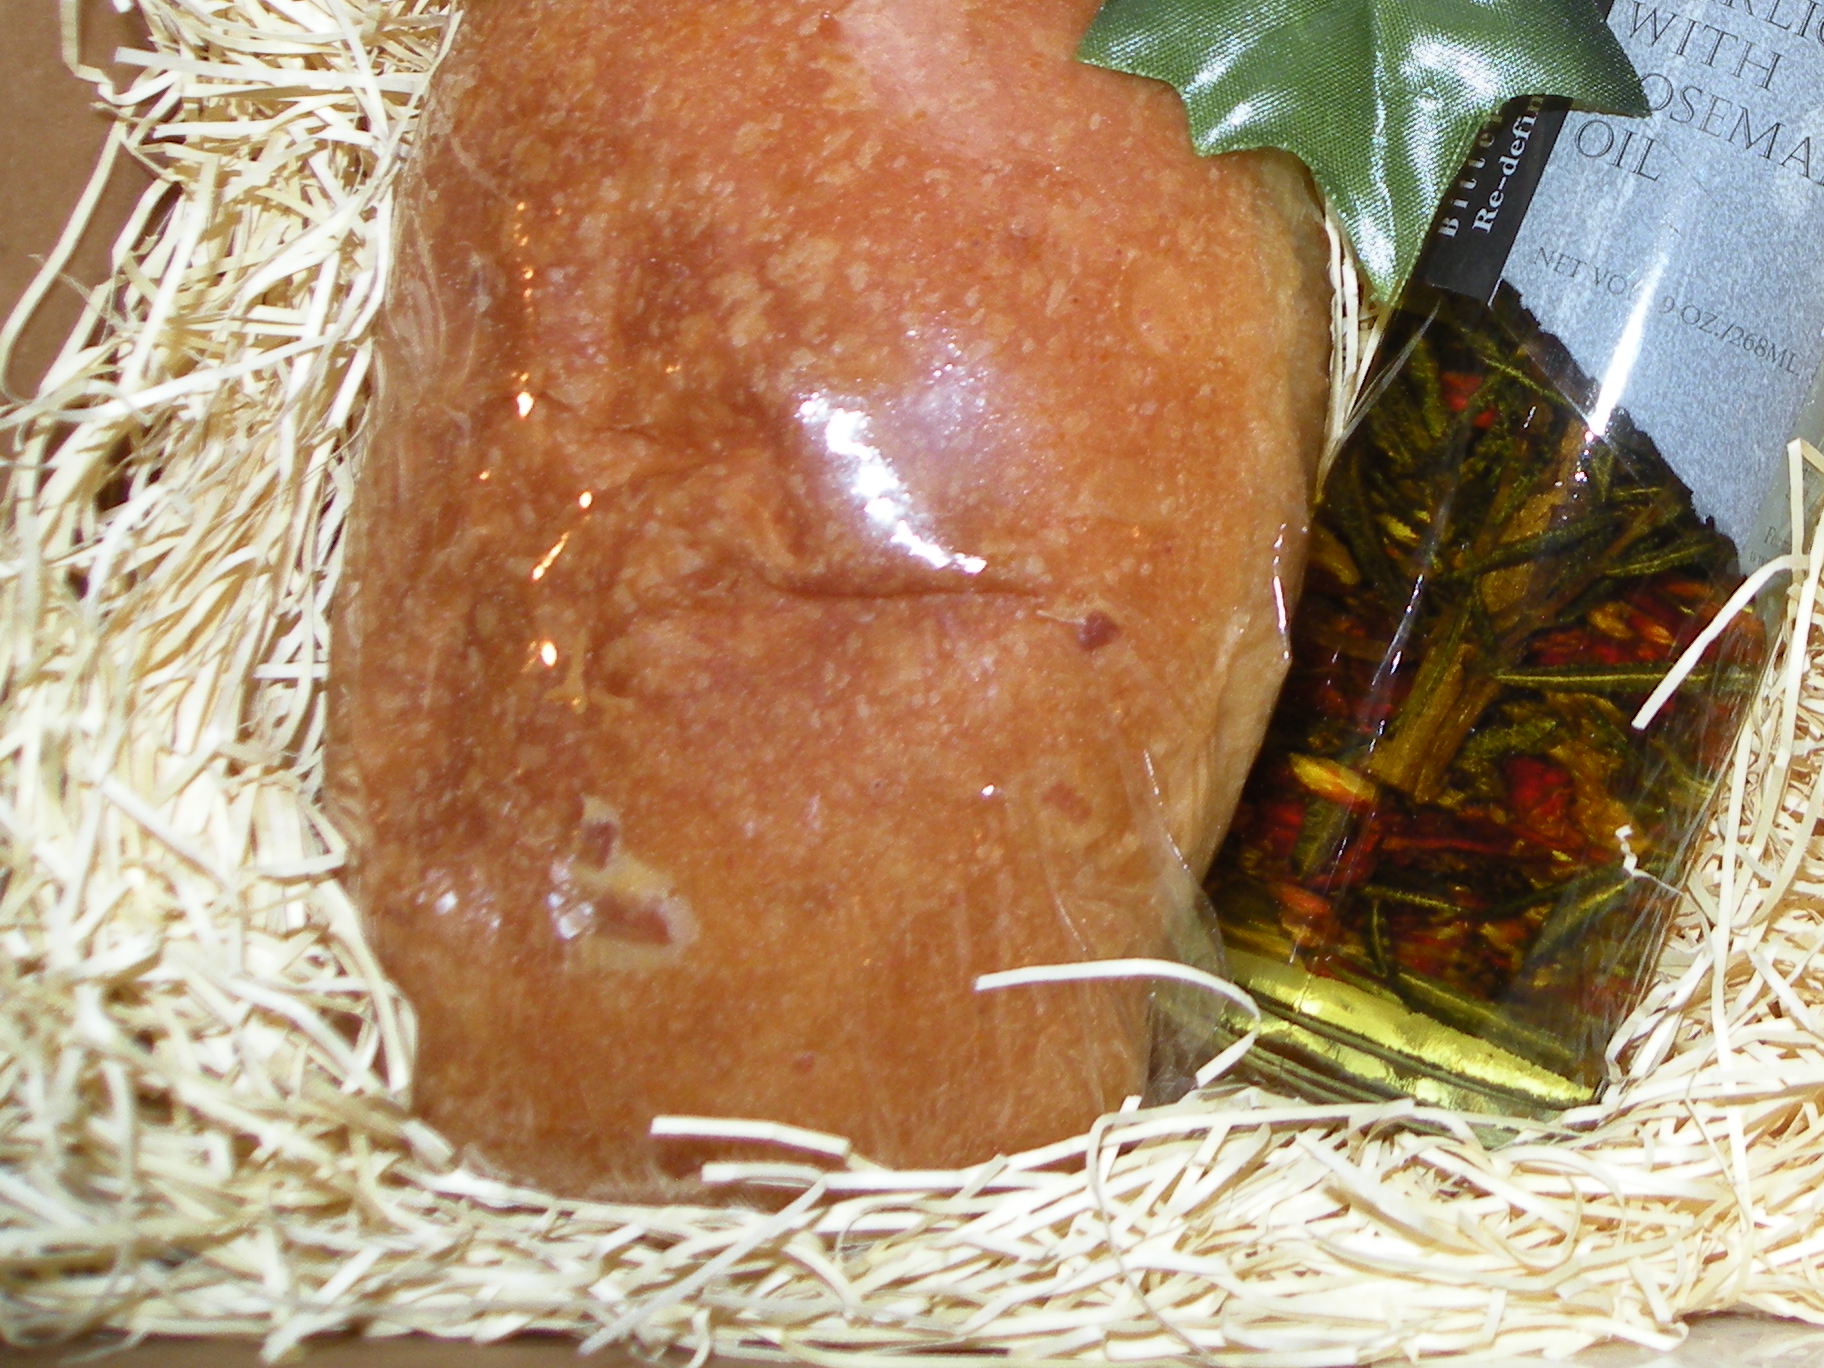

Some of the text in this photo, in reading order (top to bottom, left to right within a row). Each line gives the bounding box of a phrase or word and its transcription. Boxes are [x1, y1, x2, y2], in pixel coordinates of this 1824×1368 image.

[1628, 0, 1784, 92] WITH
[1472, 95, 1544, 234] Re-defin
[1574, 119, 1661, 183] OIL
[1533, 246, 1588, 279] NET
